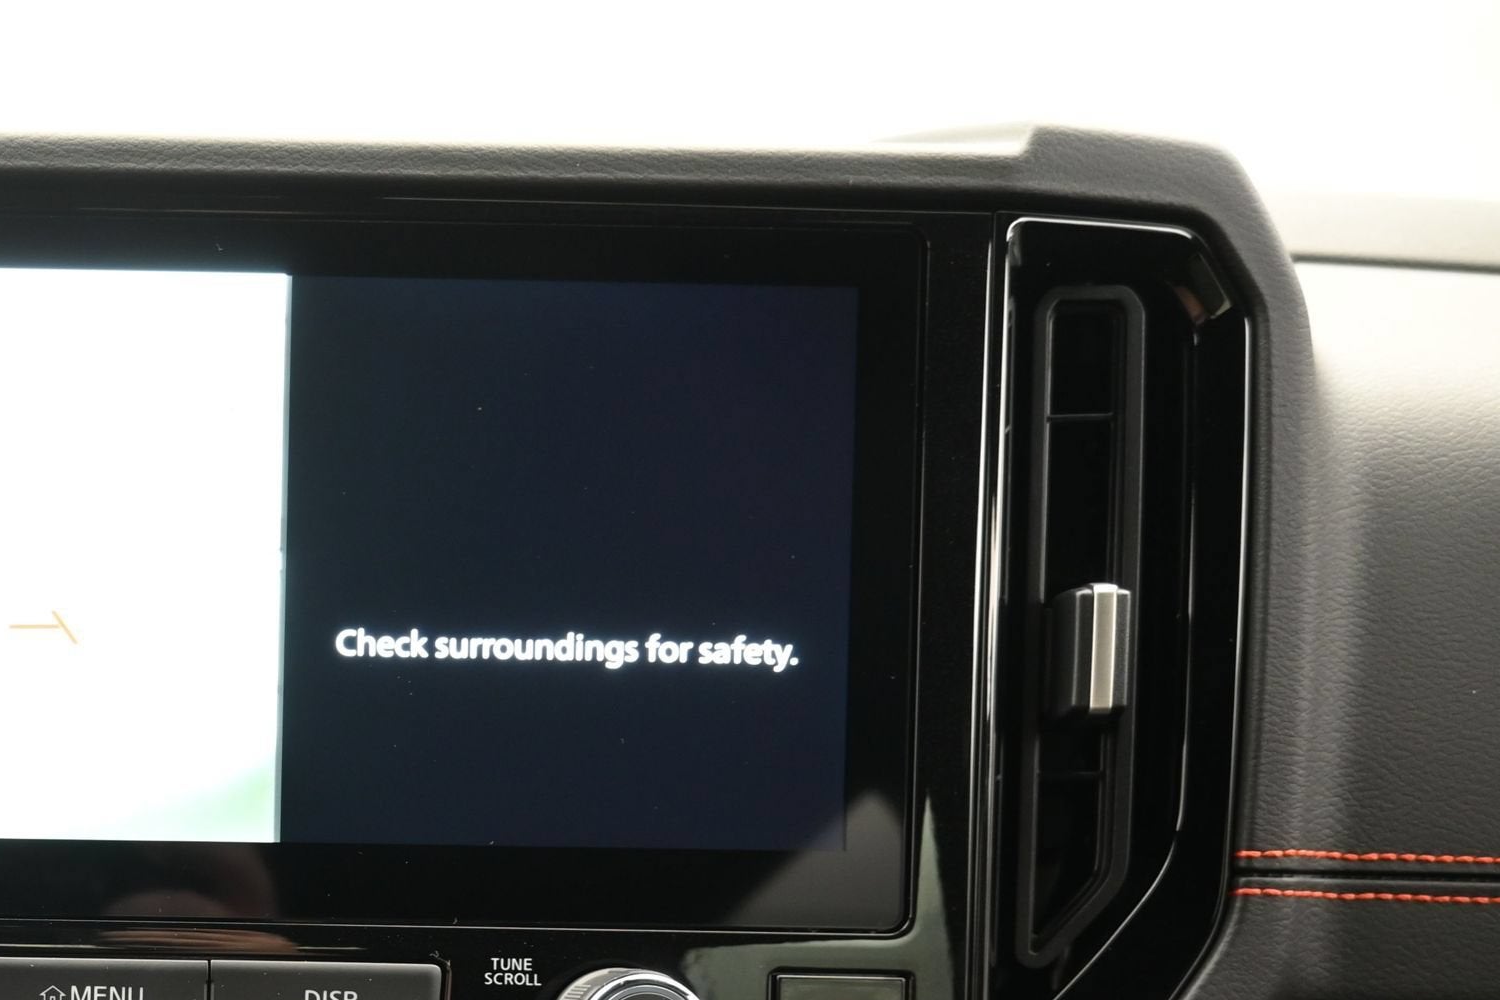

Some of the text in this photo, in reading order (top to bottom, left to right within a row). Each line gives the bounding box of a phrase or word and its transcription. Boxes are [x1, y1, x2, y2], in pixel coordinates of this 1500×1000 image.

[335, 628, 800, 673] Check surroundings for safety.
[490, 957, 533, 972] TUNE
[484, 972, 542, 986] SCROLL
